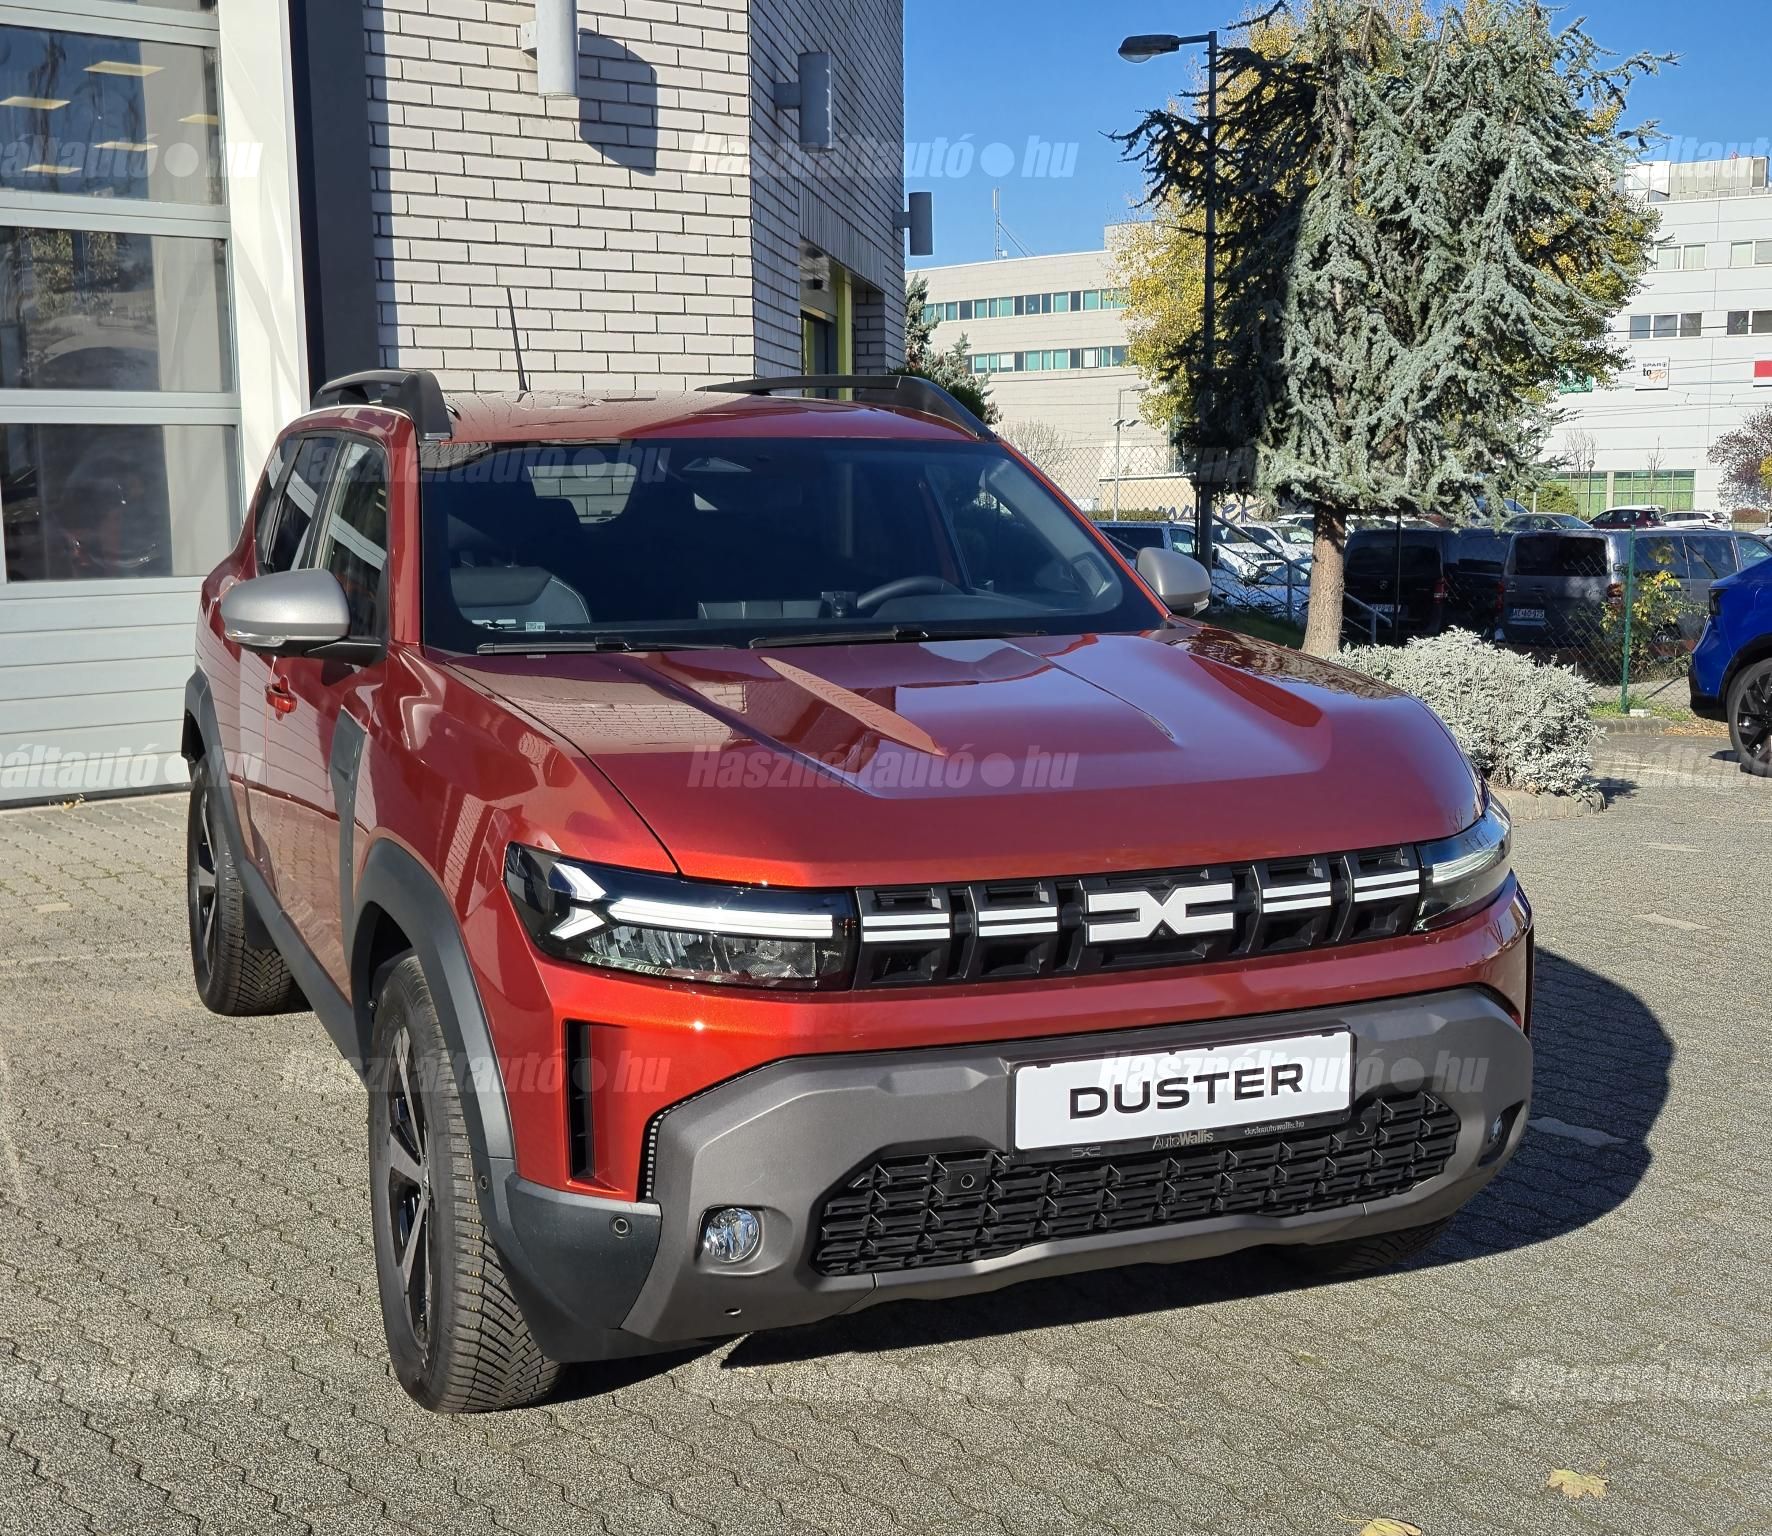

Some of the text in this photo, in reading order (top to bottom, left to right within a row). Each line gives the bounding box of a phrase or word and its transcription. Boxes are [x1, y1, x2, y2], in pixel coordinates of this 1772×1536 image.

[1642, 368, 1652, 376] to
[1069, 1063, 1304, 1120] DUSTER
[1152, 1128, 1215, 1150] AutoWallis
